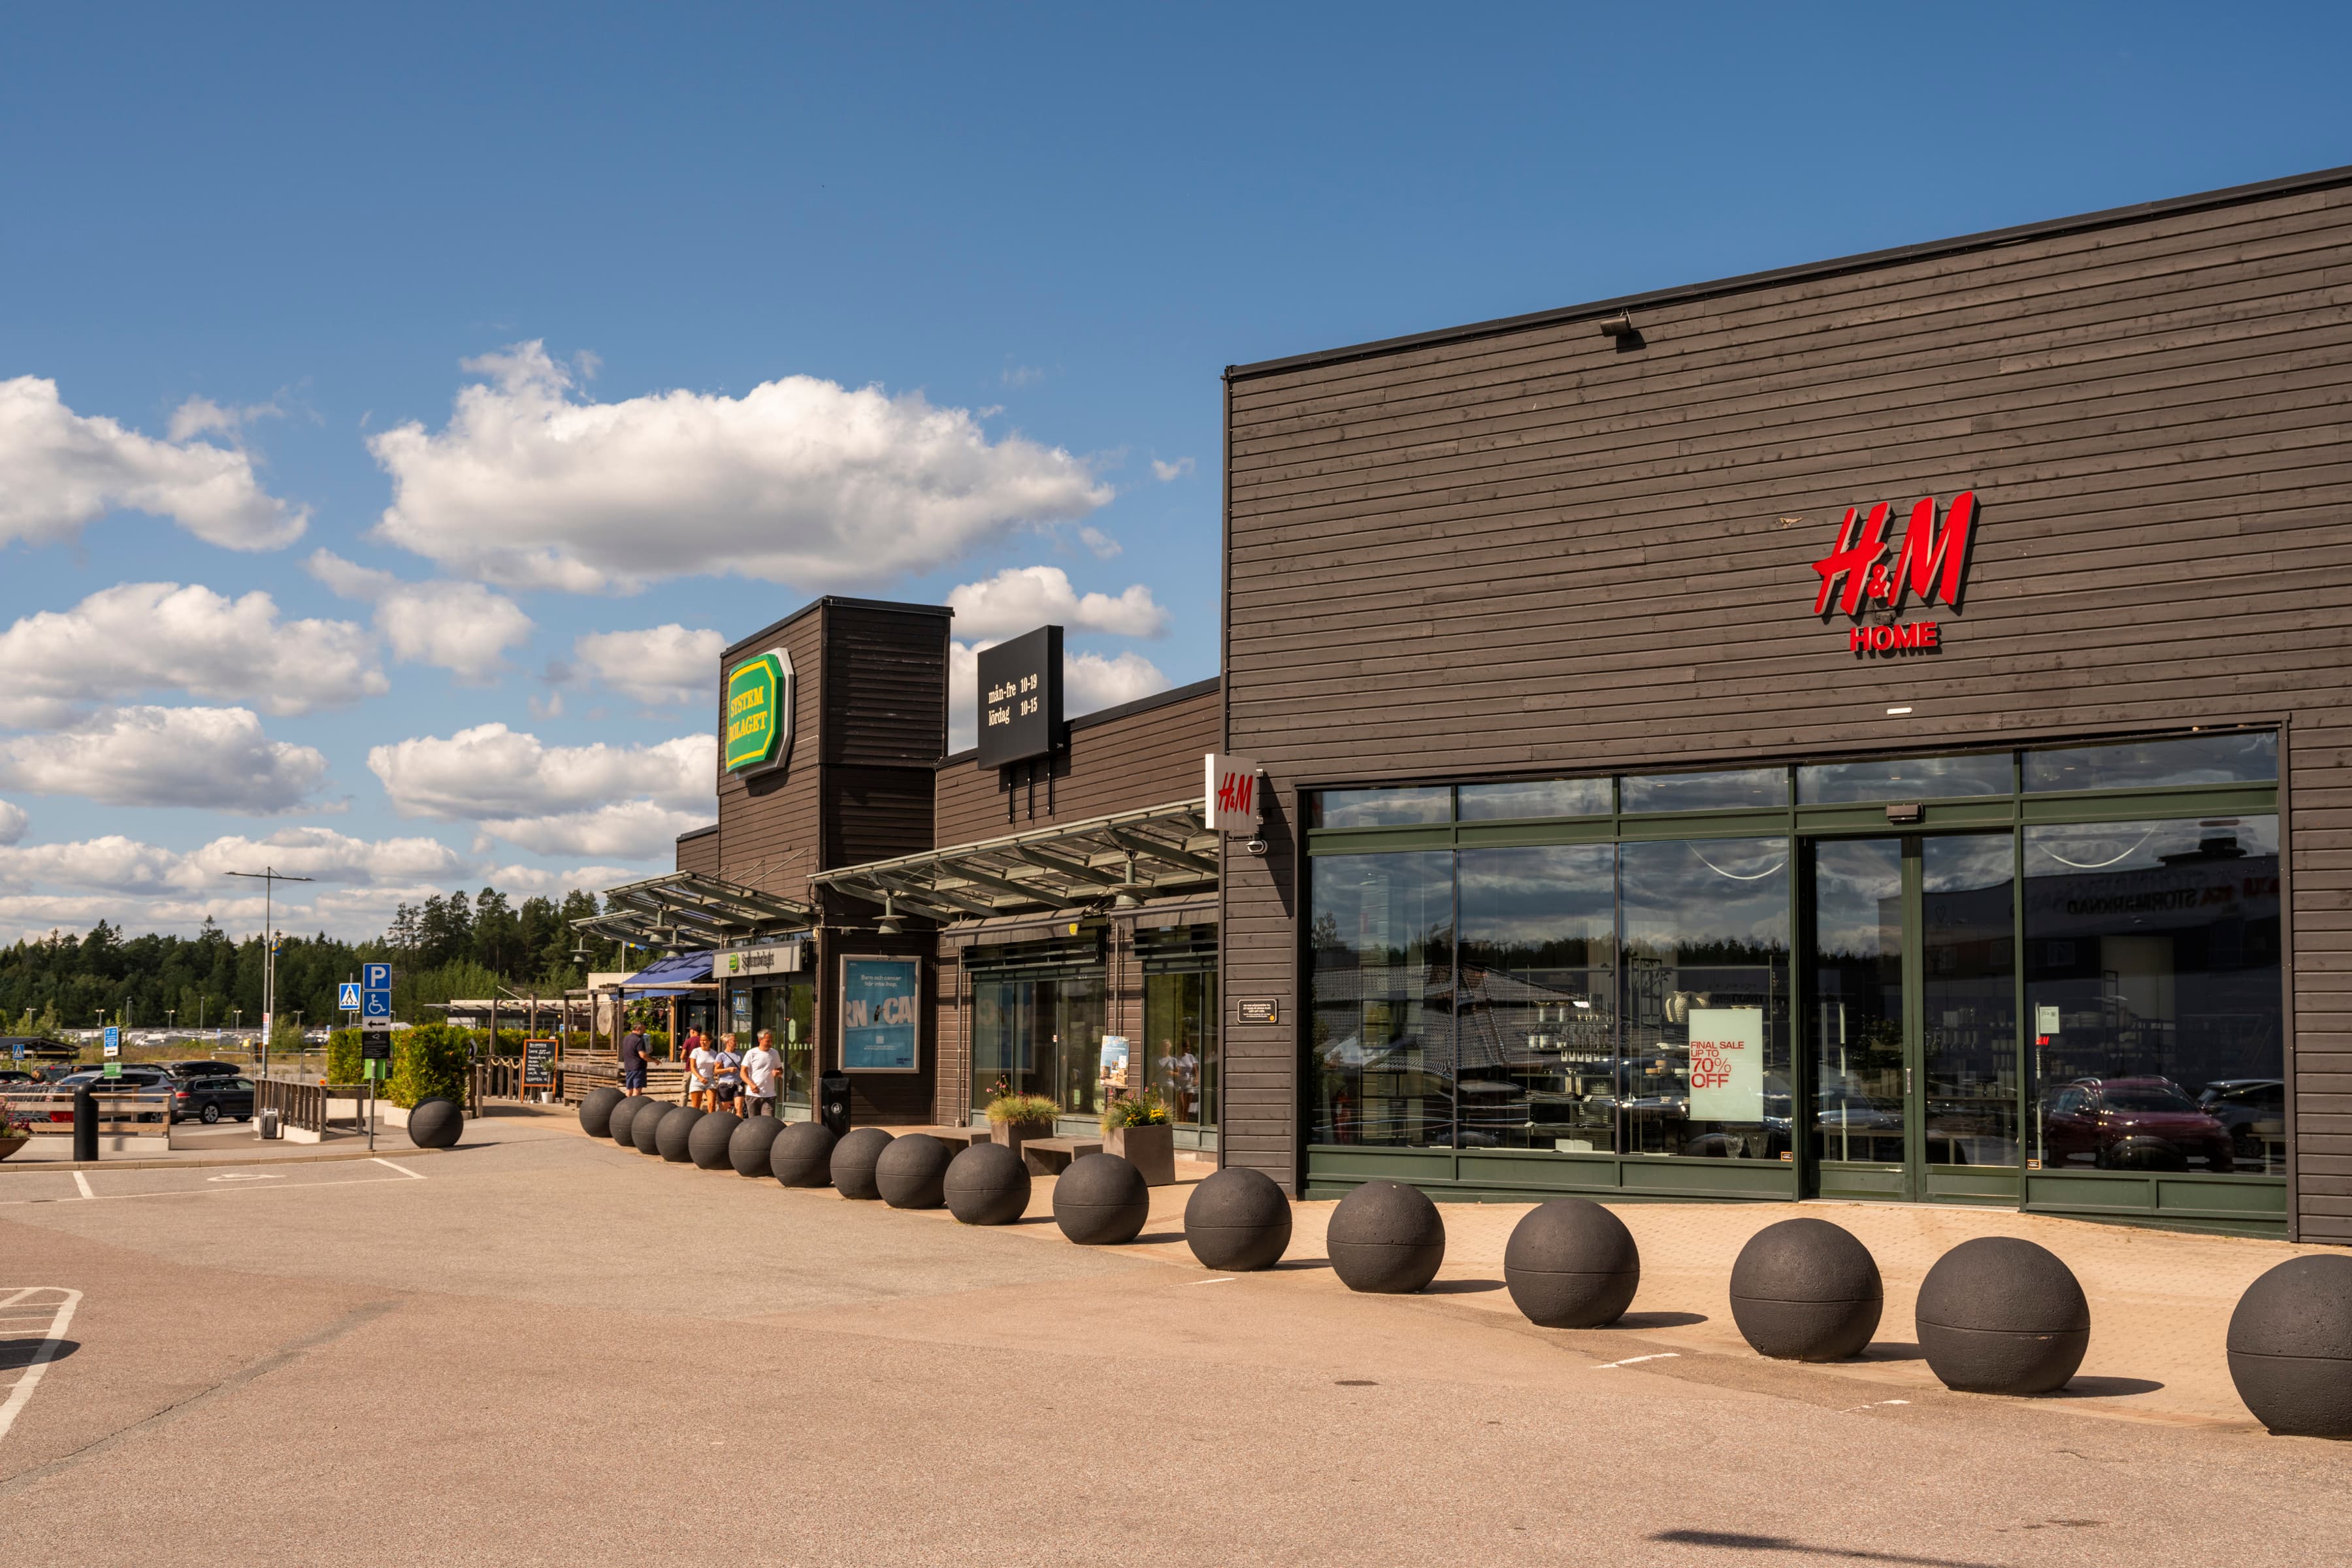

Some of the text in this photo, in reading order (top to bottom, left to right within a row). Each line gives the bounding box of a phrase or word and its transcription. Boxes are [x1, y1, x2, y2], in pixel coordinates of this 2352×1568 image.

[1812, 491, 1975, 616] H&M
[1850, 621, 1938, 652] HOME
[730, 685, 764, 718] SYSTEM
[988, 674, 1037, 704] mån-fre 10-19
[728, 710, 768, 744] BOLAGET
[988, 696, 1037, 727] lördag 10-15
[1218, 772, 1253, 816] H&M
[371, 966, 386, 987] P
[1719, 1041, 1744, 1049] SALE
[1691, 1058, 1731, 1073] 70%
[1691, 1073, 1729, 1088] OFF
